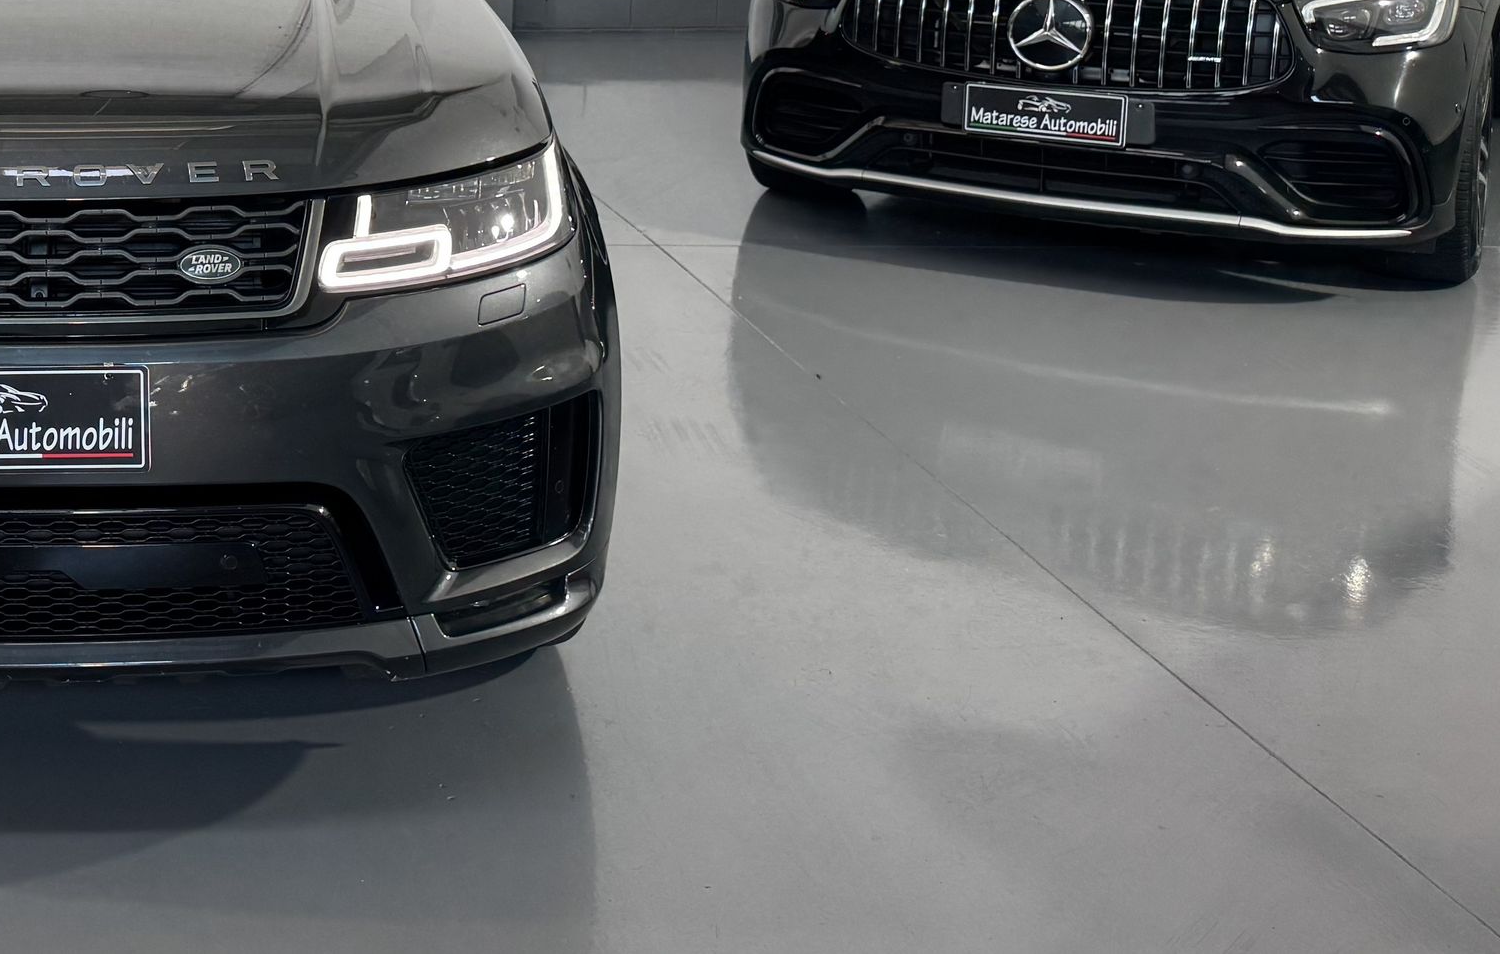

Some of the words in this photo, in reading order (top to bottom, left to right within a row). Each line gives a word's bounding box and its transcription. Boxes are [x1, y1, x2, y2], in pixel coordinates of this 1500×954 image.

[970, 106, 1037, 128] Matarese
[1040, 113, 1117, 136] Automobili
[16, 159, 280, 187] ROVER
[191, 254, 222, 265] LAND
[194, 263, 233, 274] ROVER
